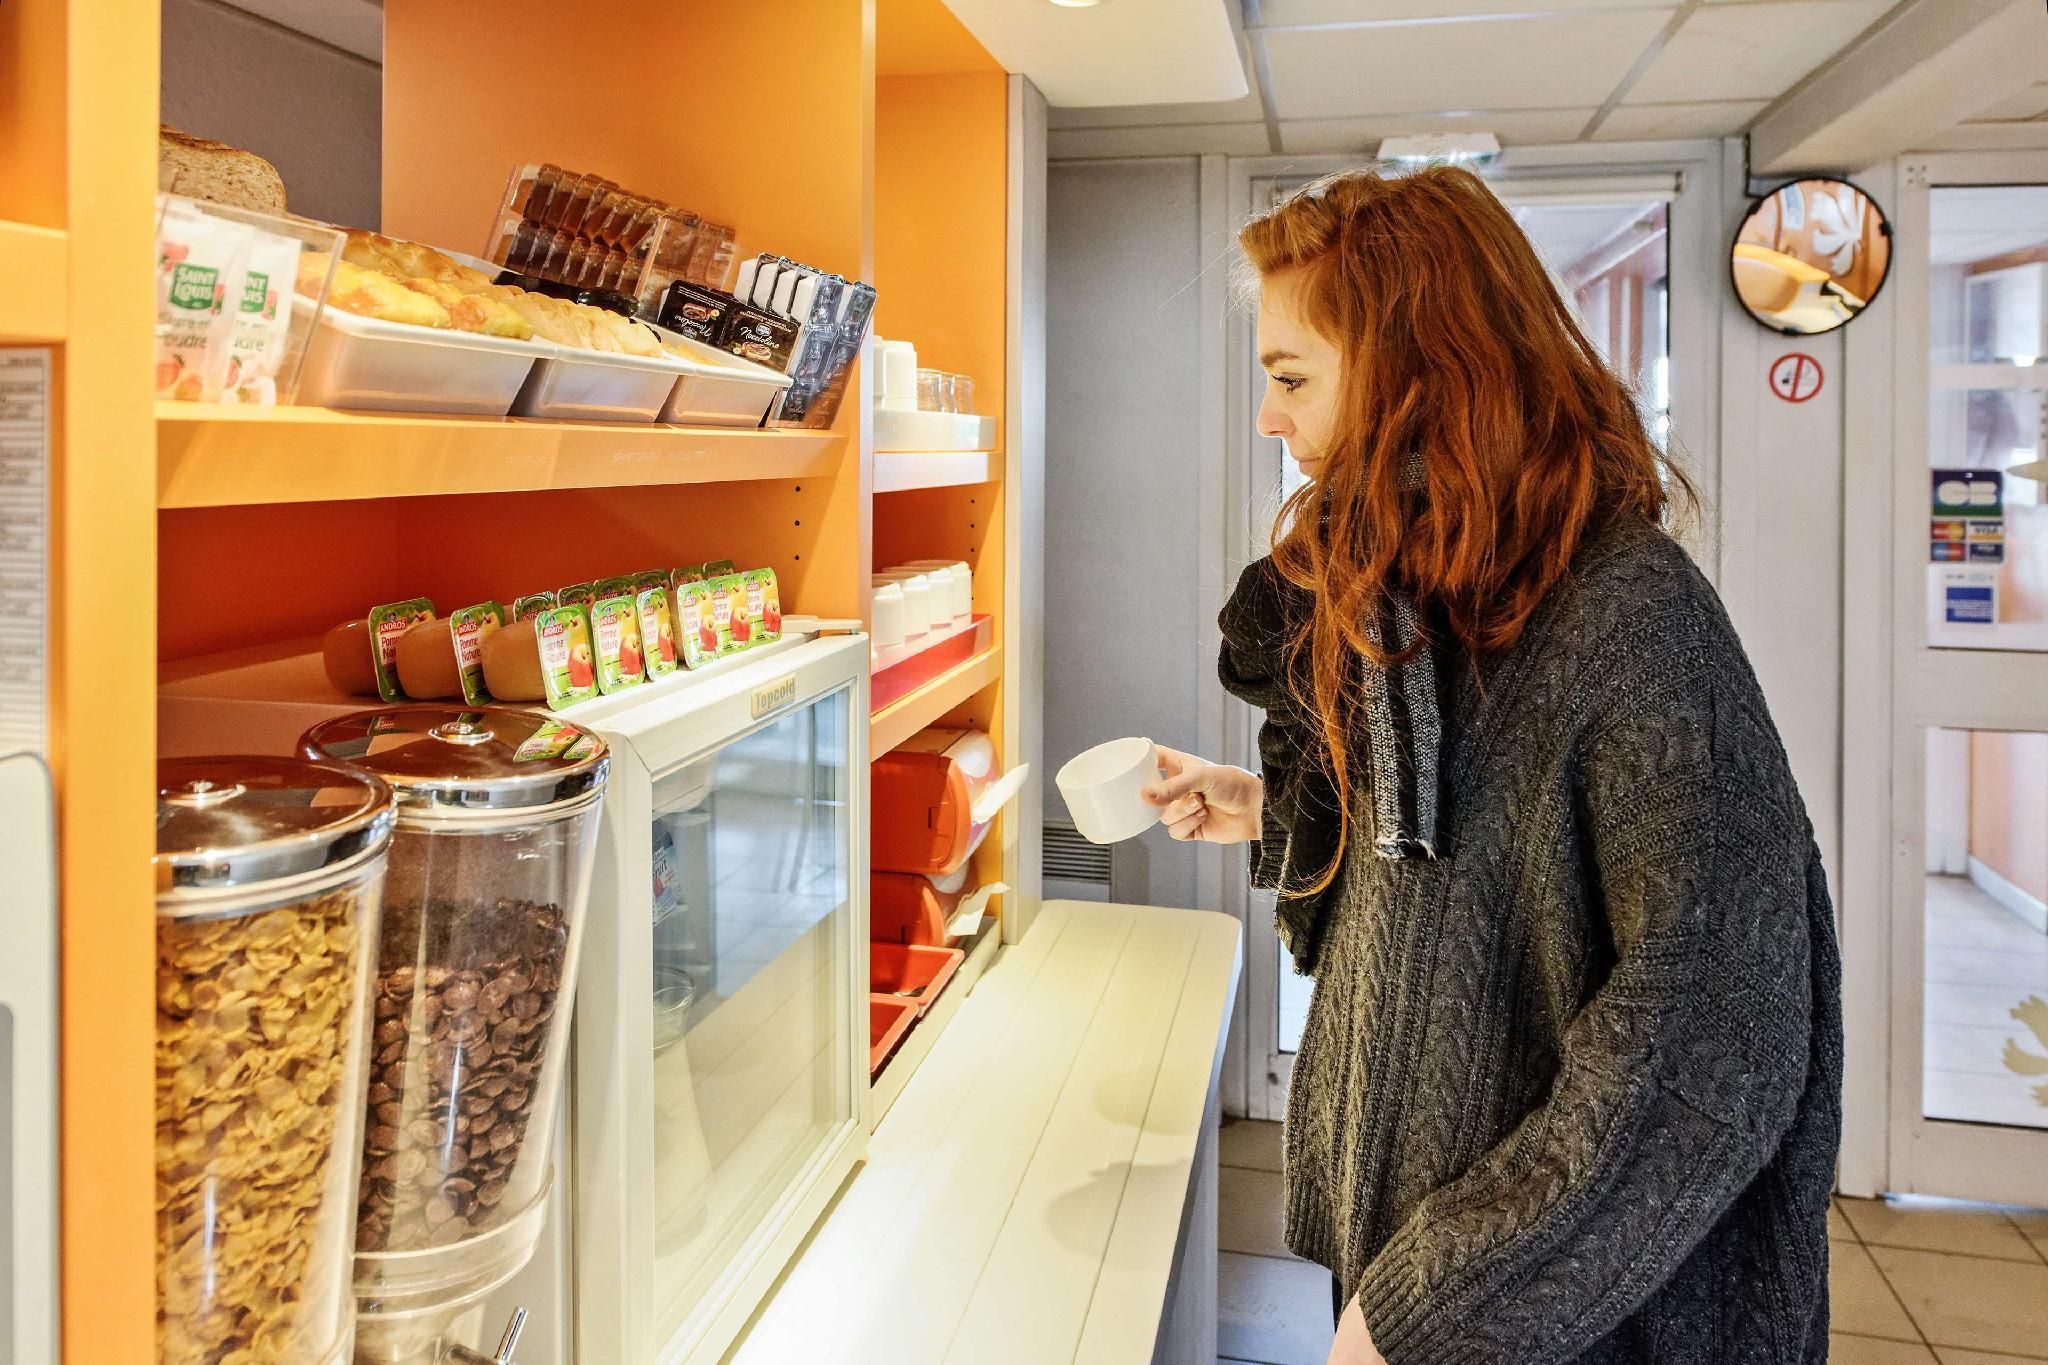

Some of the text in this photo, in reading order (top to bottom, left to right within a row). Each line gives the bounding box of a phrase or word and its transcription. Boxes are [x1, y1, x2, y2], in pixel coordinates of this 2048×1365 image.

[176, 266, 216, 286] SAINT
[173, 281, 213, 302] LOUIS
[381, 619, 406, 632] ANDROS
